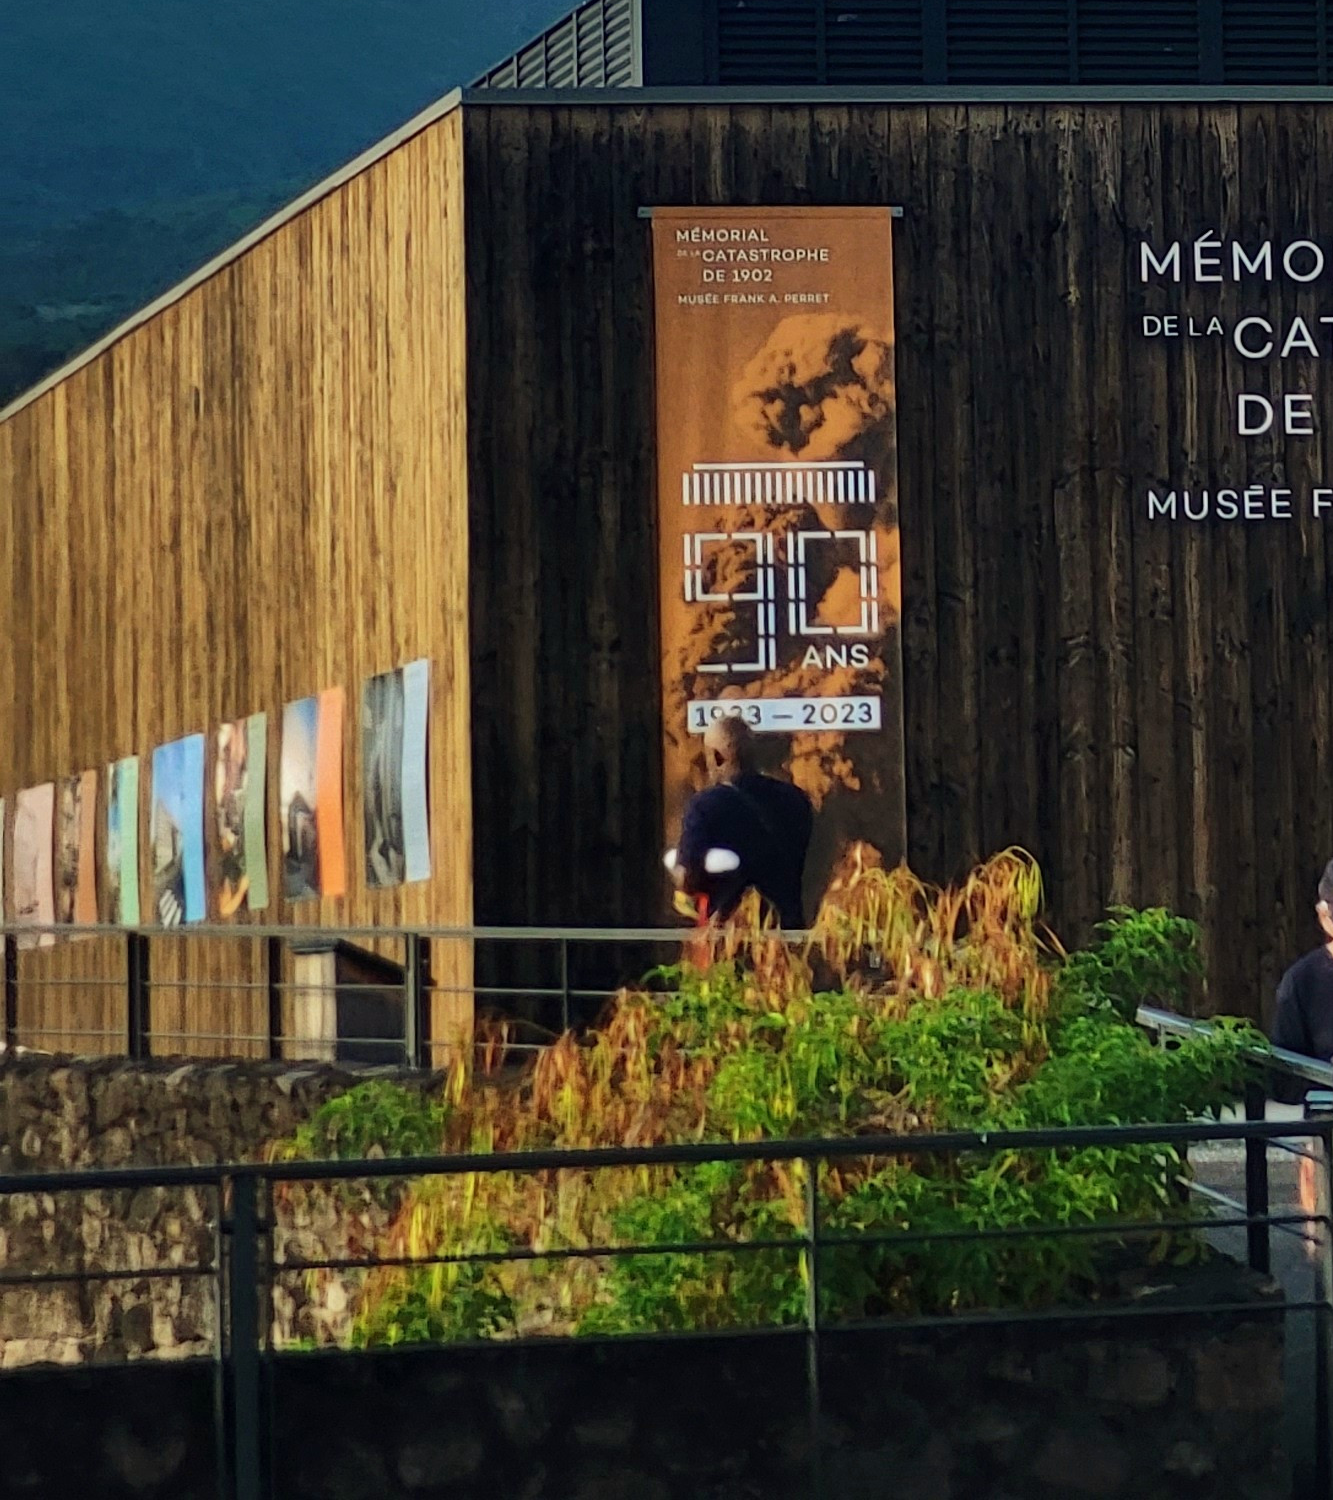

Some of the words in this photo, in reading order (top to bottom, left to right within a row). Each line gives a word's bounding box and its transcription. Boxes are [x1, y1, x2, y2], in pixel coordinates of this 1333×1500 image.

[676, 226, 769, 242] MÉMORIAL
[702, 248, 830, 263] CATASTROPHE
[703, 269, 725, 282] DE
[732, 268, 773, 282] 1902
[677, 292, 720, 305] MUSÉE
[723, 293, 766, 304] FRANK
[784, 293, 830, 304] PERRET
[1143, 315, 1179, 337] DE
[1189, 316, 1224, 336] LA
[1237, 394, 1314, 435] DE
[1147, 485, 1292, 520] MUSÉE
[801, 643, 870, 670] ANS
[801, 702, 873, 725] 2023
